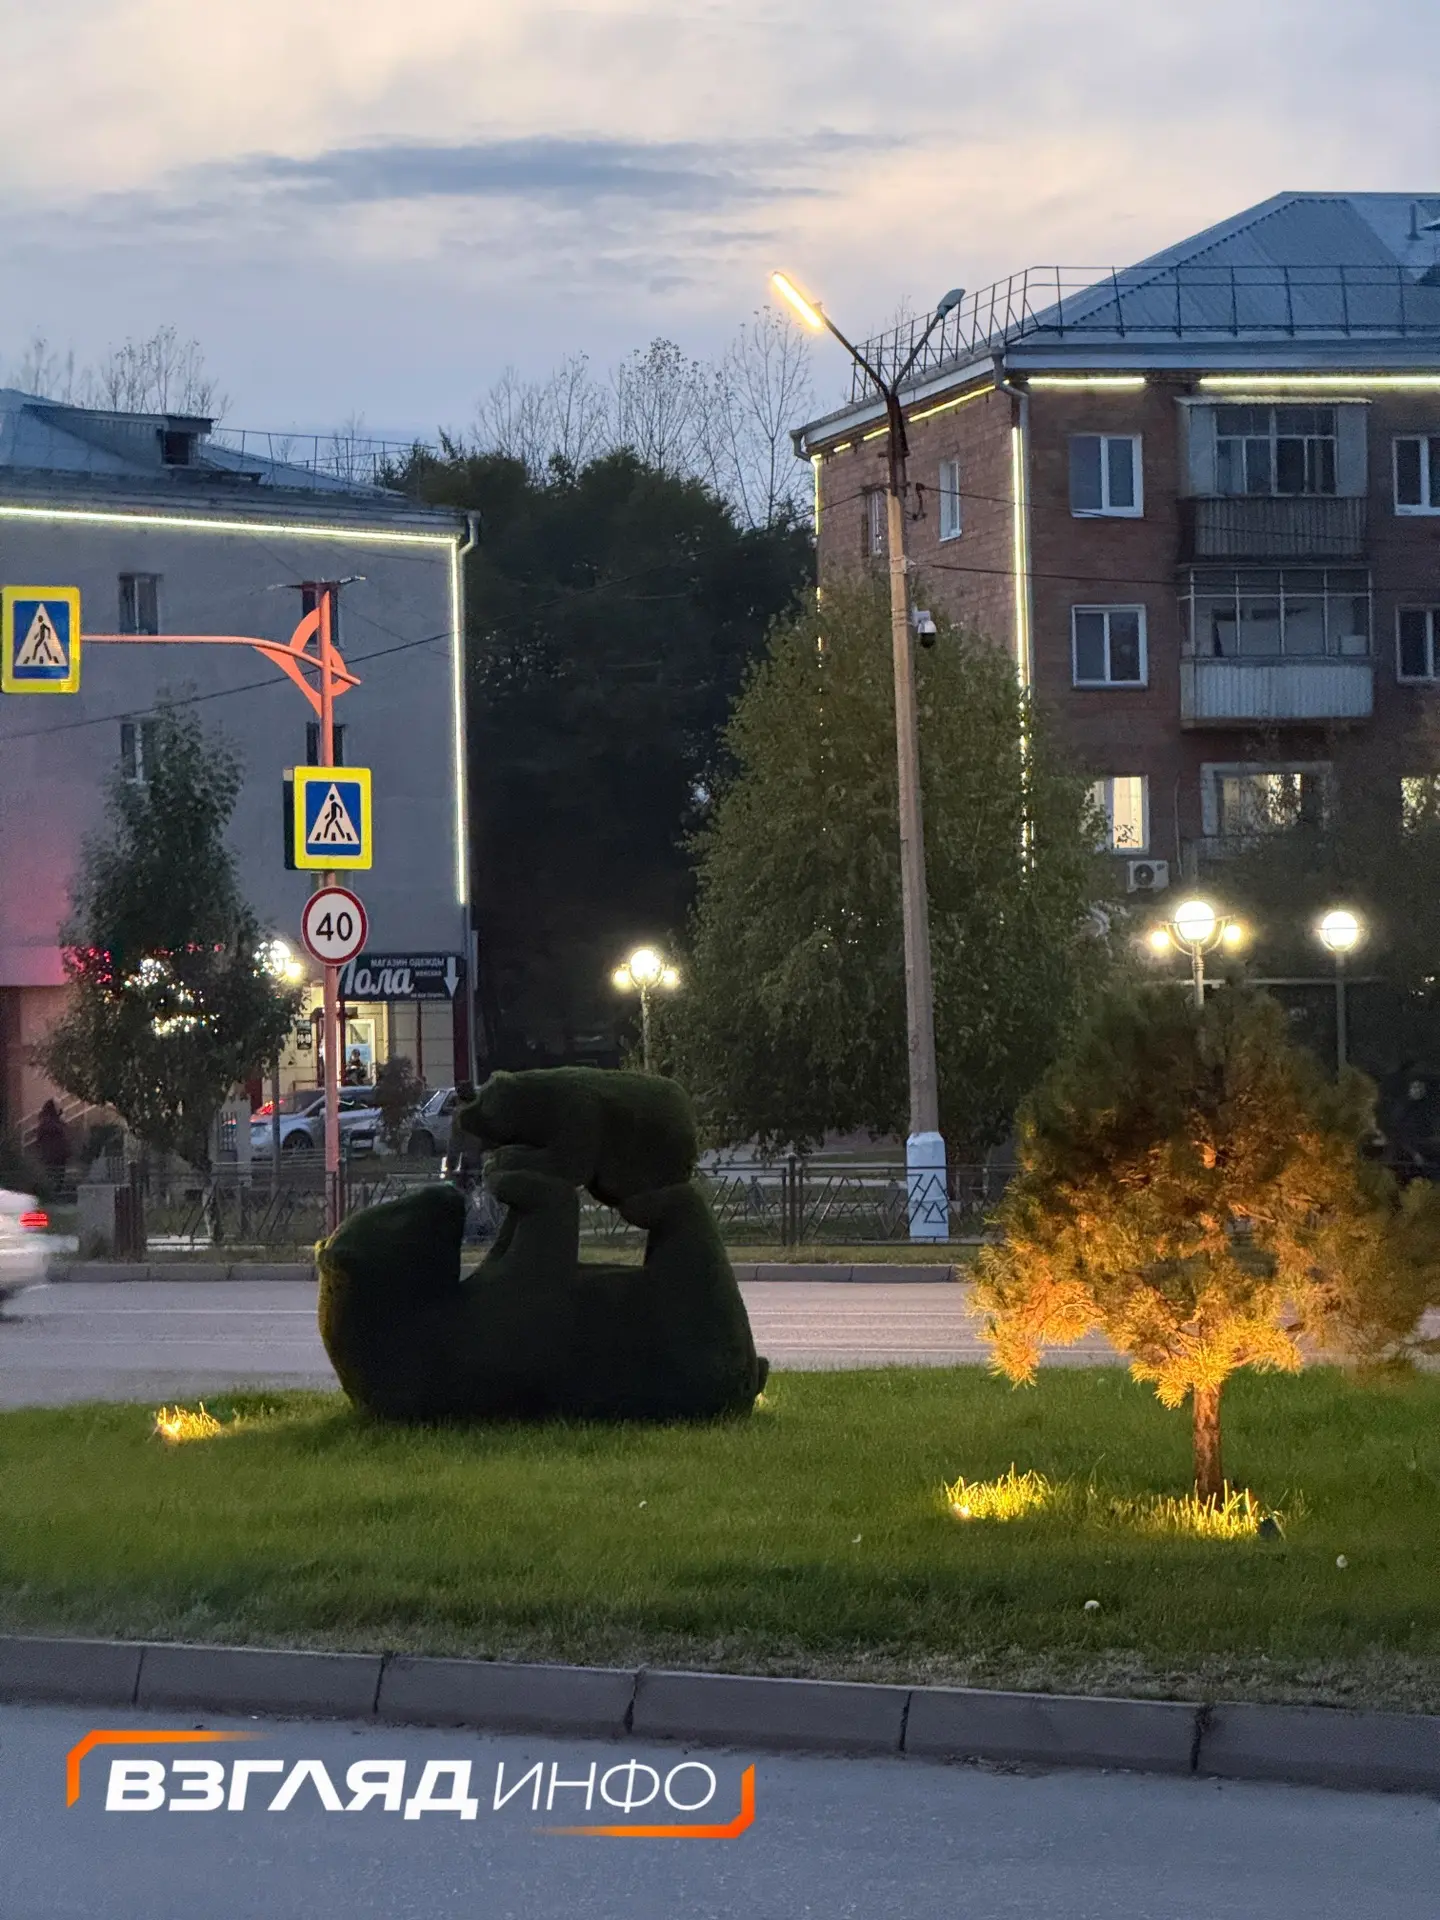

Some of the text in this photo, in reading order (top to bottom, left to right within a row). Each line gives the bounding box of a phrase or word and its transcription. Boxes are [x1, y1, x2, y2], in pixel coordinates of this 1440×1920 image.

[316, 912, 353, 941] 40
[371, 958, 444, 967] МАГАЗИН ОДЕЖДЫ
